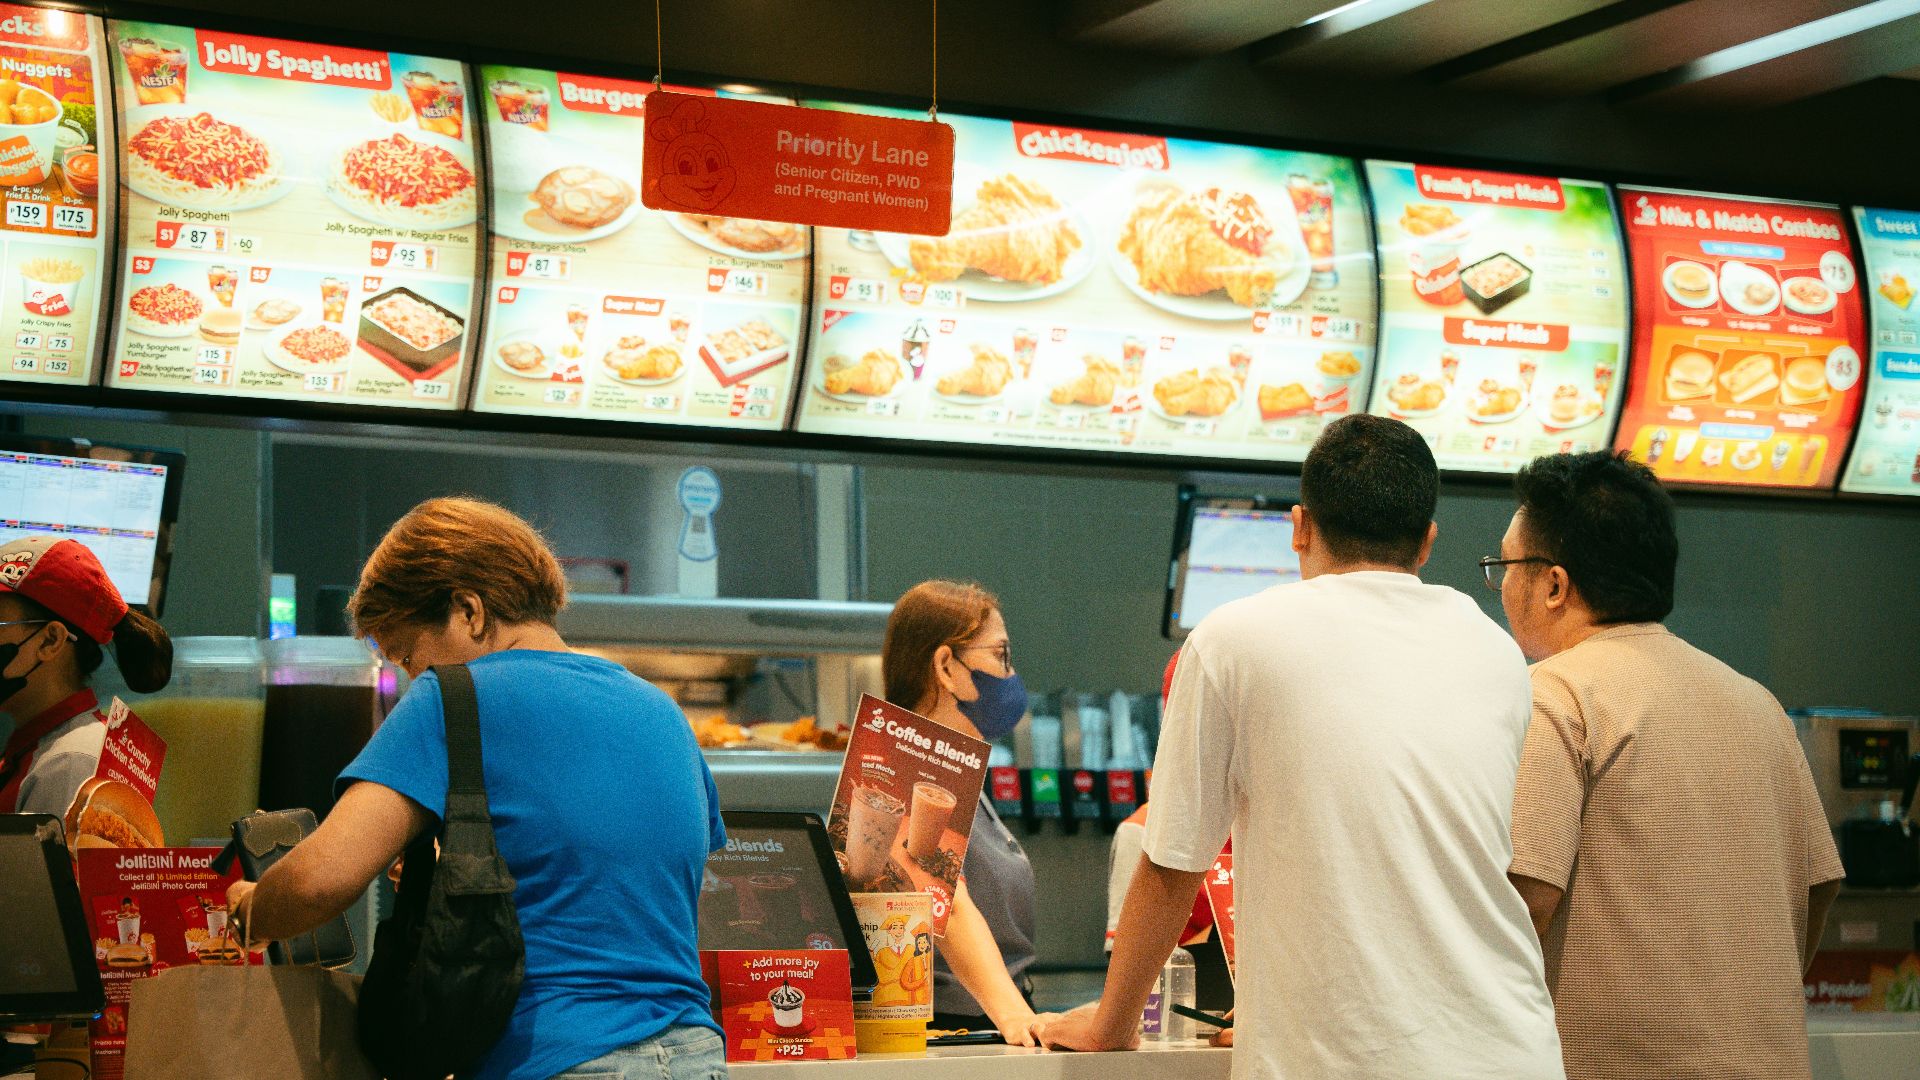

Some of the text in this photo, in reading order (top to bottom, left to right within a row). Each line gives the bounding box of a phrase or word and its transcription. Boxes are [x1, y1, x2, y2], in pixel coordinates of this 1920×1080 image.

[0, 16, 45, 37] cks
[2, 57, 72, 79] Nuggets
[203, 41, 383, 81] Jolly Spaghetti
[141, 74, 179, 89] NESTEA
[560, 82, 646, 112] Burger
[775, 129, 930, 168] Priority Lane
[1021, 129, 1165, 170] Chickenjoy
[775, 161, 920, 190] (Senior Citizen, PWD
[1421, 174, 1472, 199] Family
[1472, 179, 1514, 202] Super
[5, 191, 23, 199] Fries
[32, 194, 51, 202] Drink
[774, 183, 929, 212] and Pregnant Women)
[158, 206, 230, 222] Jolly Spaghetti
[1659, 206, 1841, 241] Mix & Match Combos
[1875, 216, 1919, 235] Sweet
[159, 228, 175, 242] S1
[190, 230, 208, 244] 87
[325, 222, 469, 243] Jolly Spaghetti w/ Regular Fries
[239, 239, 253, 249] 60
[400, 249, 416, 262] 95
[535, 259, 549, 271] 87
[1462, 320, 1506, 345] Super
[23, 337, 36, 345] 47
[55, 339, 67, 348] 75
[127, 342, 144, 350] Jolly
[146, 343, 181, 353] Spaghetti
[126, 350, 167, 360] Yumburger
[20, 360, 33, 369] 94
[51, 362, 67, 371] 152
[201, 369, 218, 379] 140
[885, 720, 982, 770] Coffee Blends
[127, 740, 151, 770] Crunchy
[895, 741, 962, 775] Deliciously Rich Blends
[105, 736, 128, 766] Chicken
[127, 758, 157, 791] Sandwich
[875, 763, 896, 776] Mocha
[725, 837, 784, 853] Blends
[119, 873, 145, 881] Collect
[146, 873, 155, 881] all
[156, 873, 164, 881] 16
[165, 873, 192, 881] Limited
[162, 882, 183, 890] Photo
[185, 882, 208, 890] Cards!
[924, 886, 946, 899] STARTS
[775, 956, 802, 966] more
[803, 956, 820, 970] joy
[750, 969, 814, 981] to your meal!
